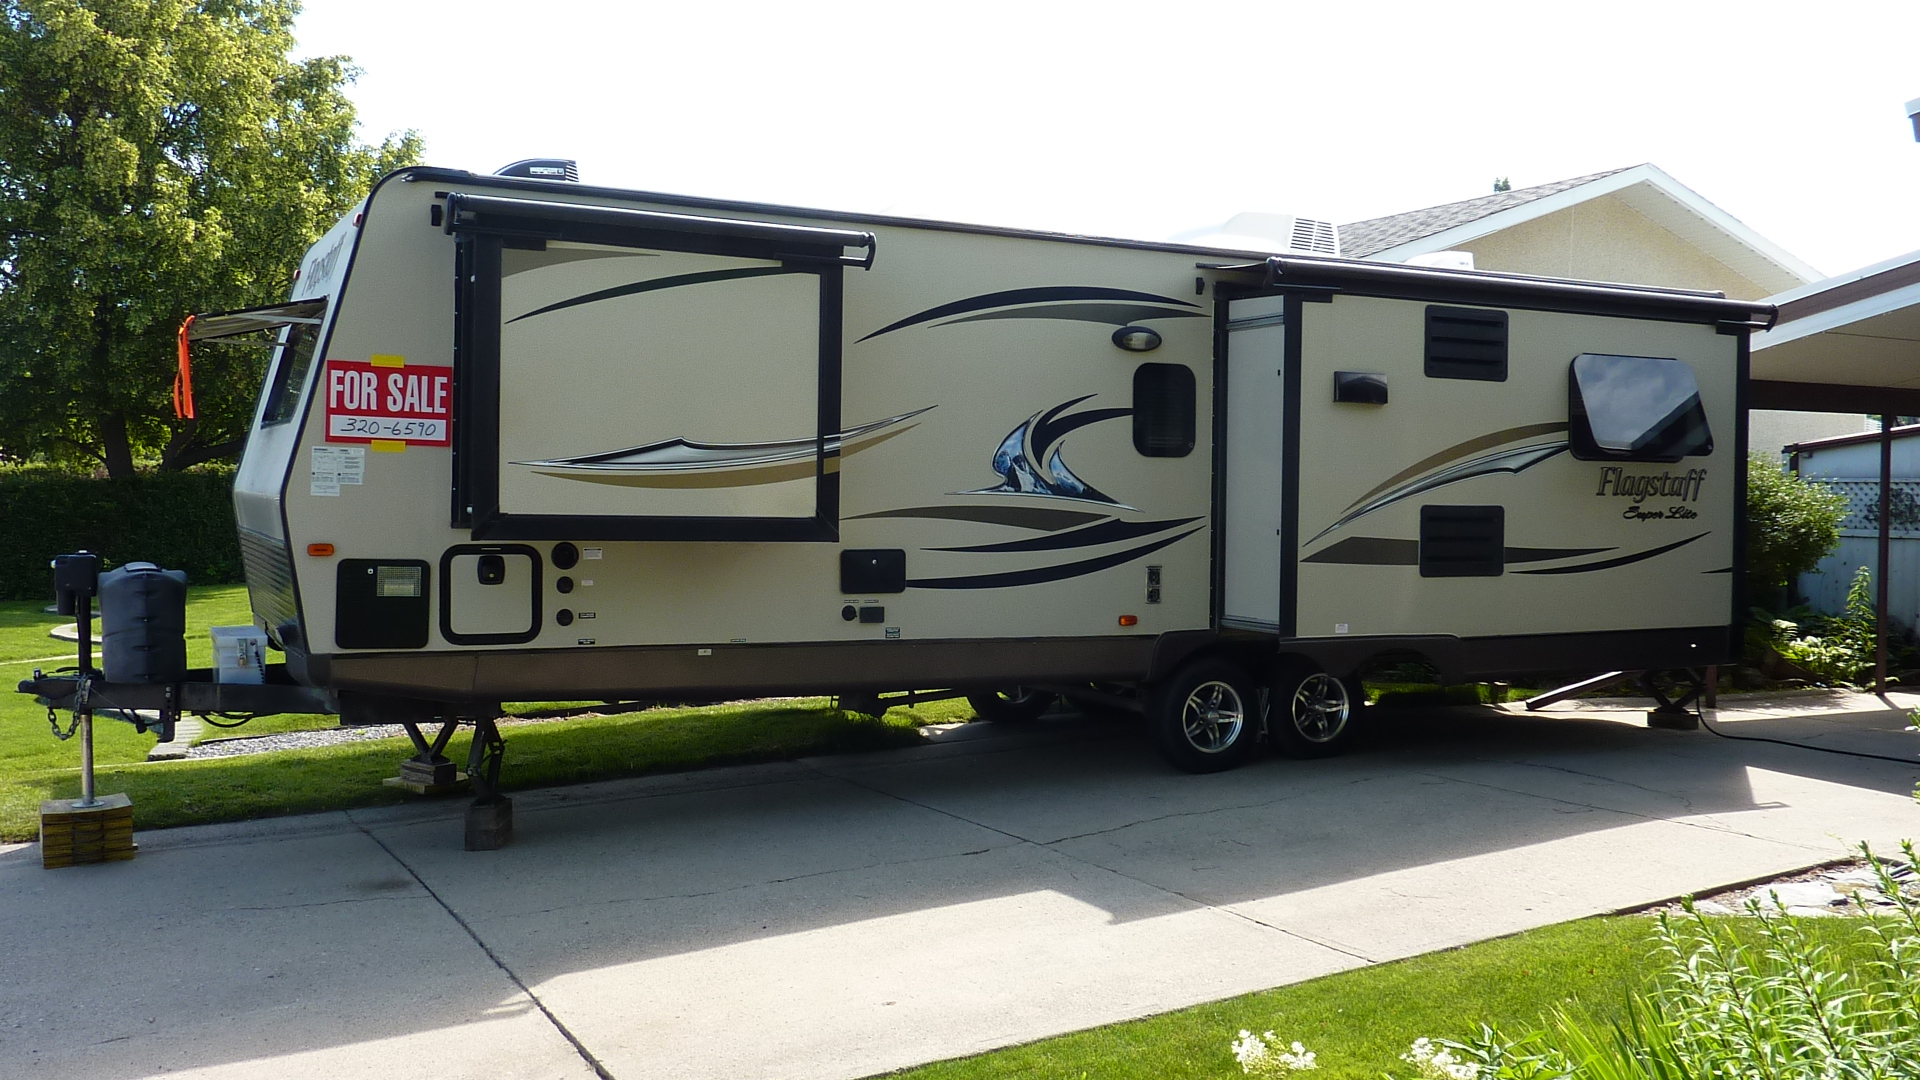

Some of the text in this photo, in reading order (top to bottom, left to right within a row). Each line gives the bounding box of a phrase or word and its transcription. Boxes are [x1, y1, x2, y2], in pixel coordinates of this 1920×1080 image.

[330, 369, 448, 414] FOR SALE
[340, 418, 436, 436] 320-6590
[1596, 466, 1707, 503] Flagstaff
[1623, 506, 1698, 521] Super Lite
